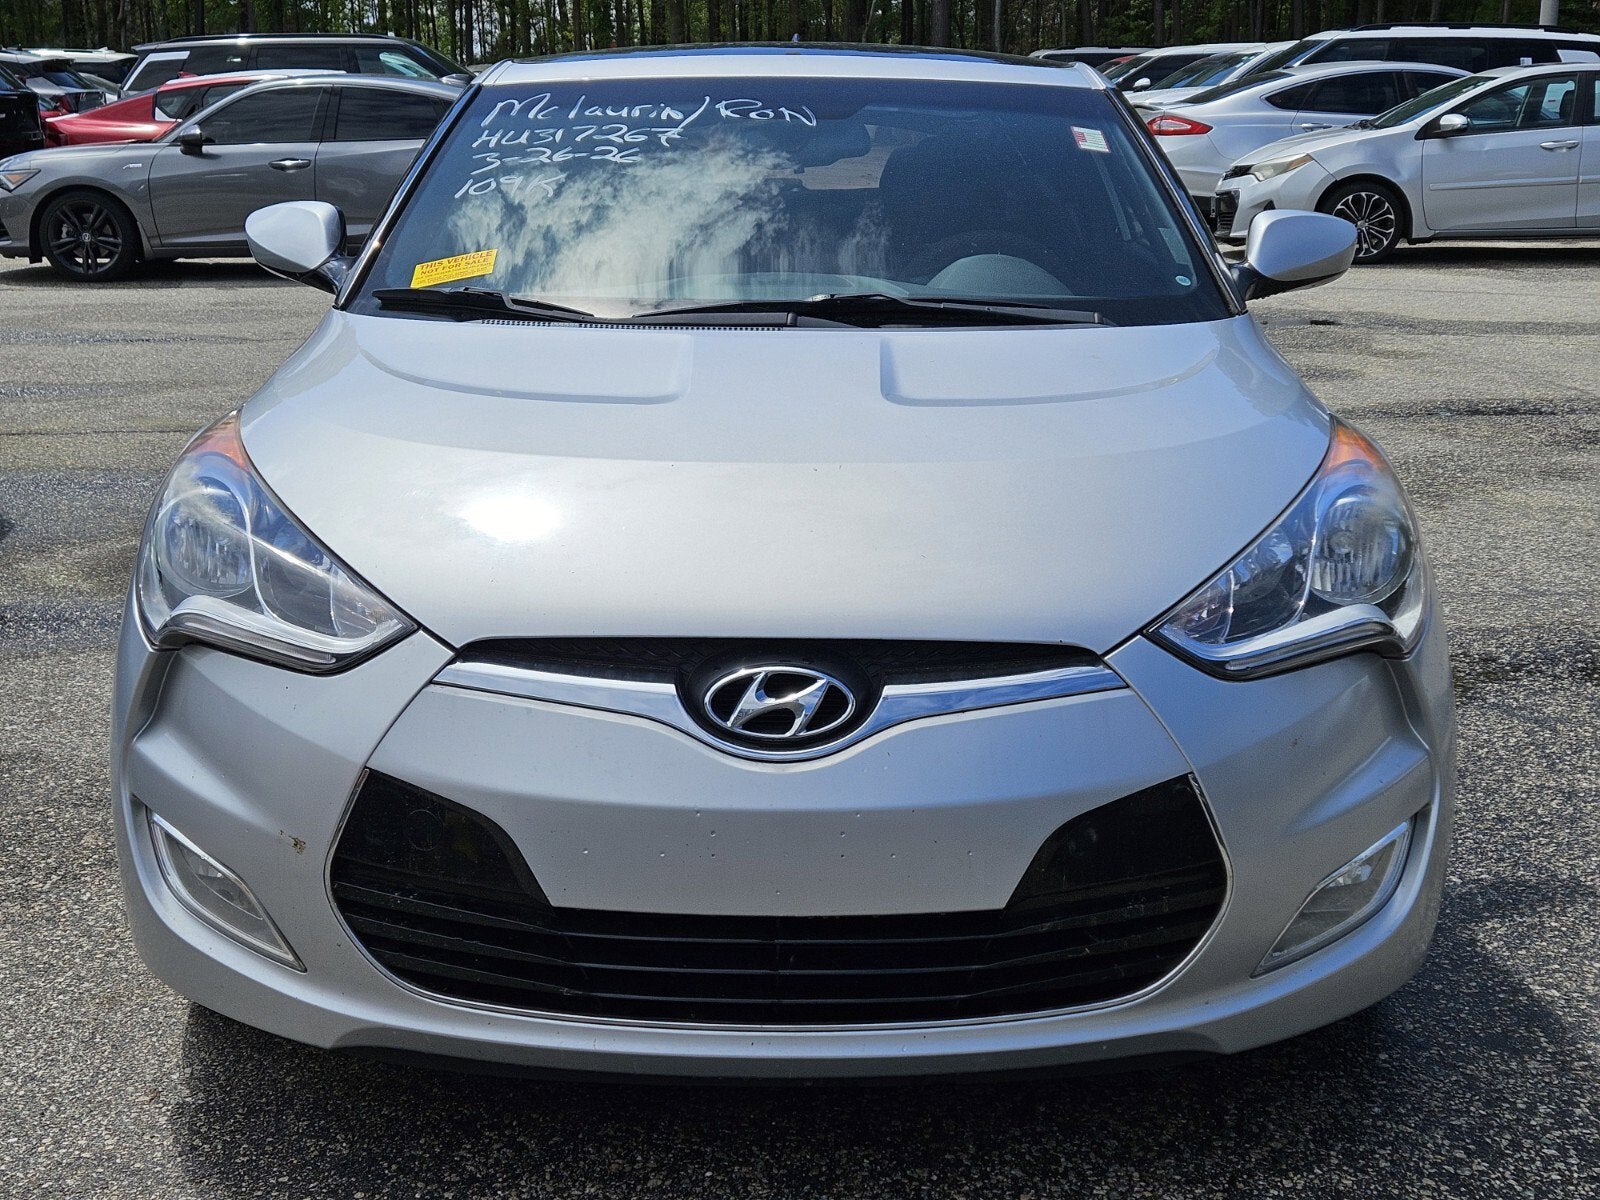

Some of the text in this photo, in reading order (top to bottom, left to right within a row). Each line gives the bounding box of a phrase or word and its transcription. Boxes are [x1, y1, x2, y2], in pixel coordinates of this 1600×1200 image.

[470, 146, 642, 175] 3-26-26
[455, 173, 567, 199] 109K
[420, 250, 493, 271] THIS VEHICLE
[420, 268, 438, 276] NOT
[442, 263, 461, 272] FOR
[465, 258, 489, 267] SALE
